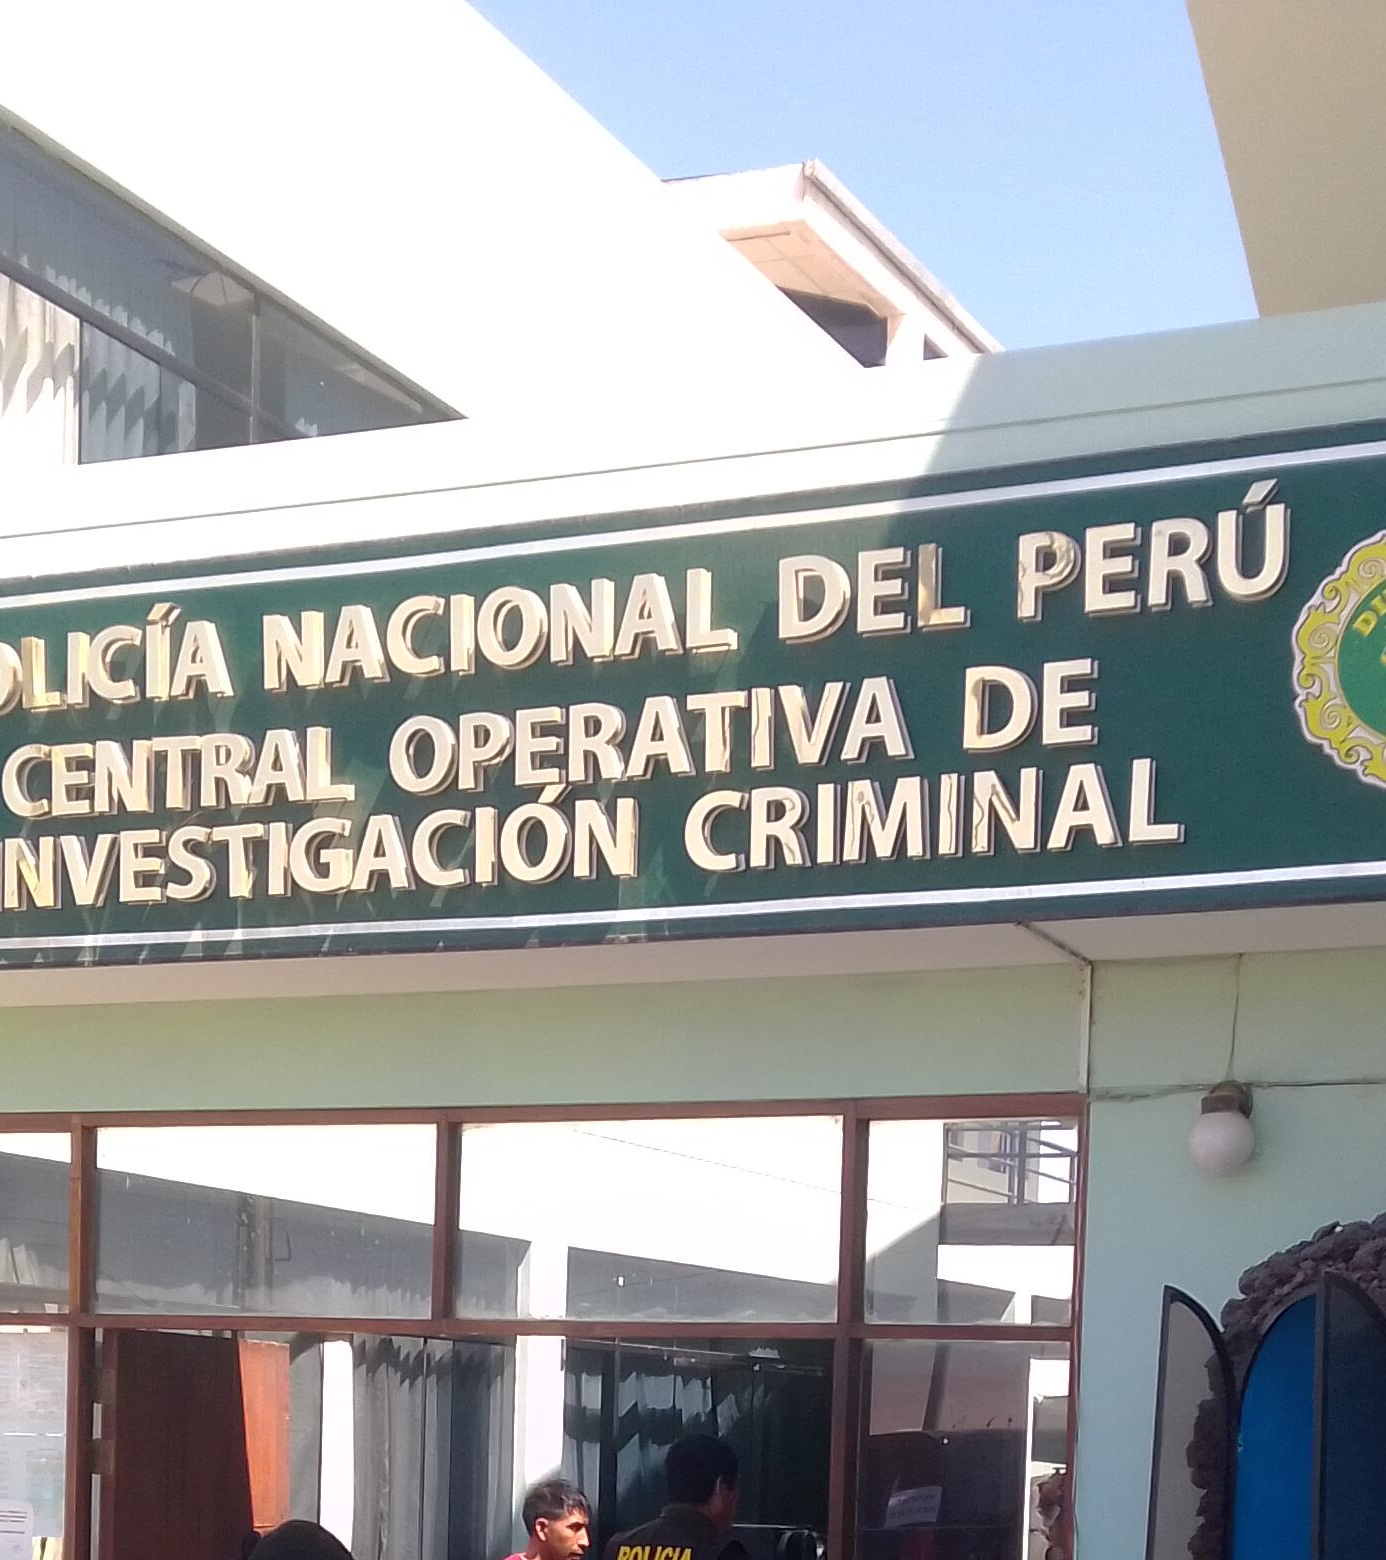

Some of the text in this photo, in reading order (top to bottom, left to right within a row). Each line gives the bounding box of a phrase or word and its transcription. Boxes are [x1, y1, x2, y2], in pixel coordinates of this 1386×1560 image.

[262, 567, 738, 692] NACIONAL
[777, 541, 971, 643] DEL
[1016, 478, 1292, 621] PERÚ
[1, 657, 1100, 819] CENTRAL OPERATIVA DE
[684, 757, 1185, 874] CRIMINAL
